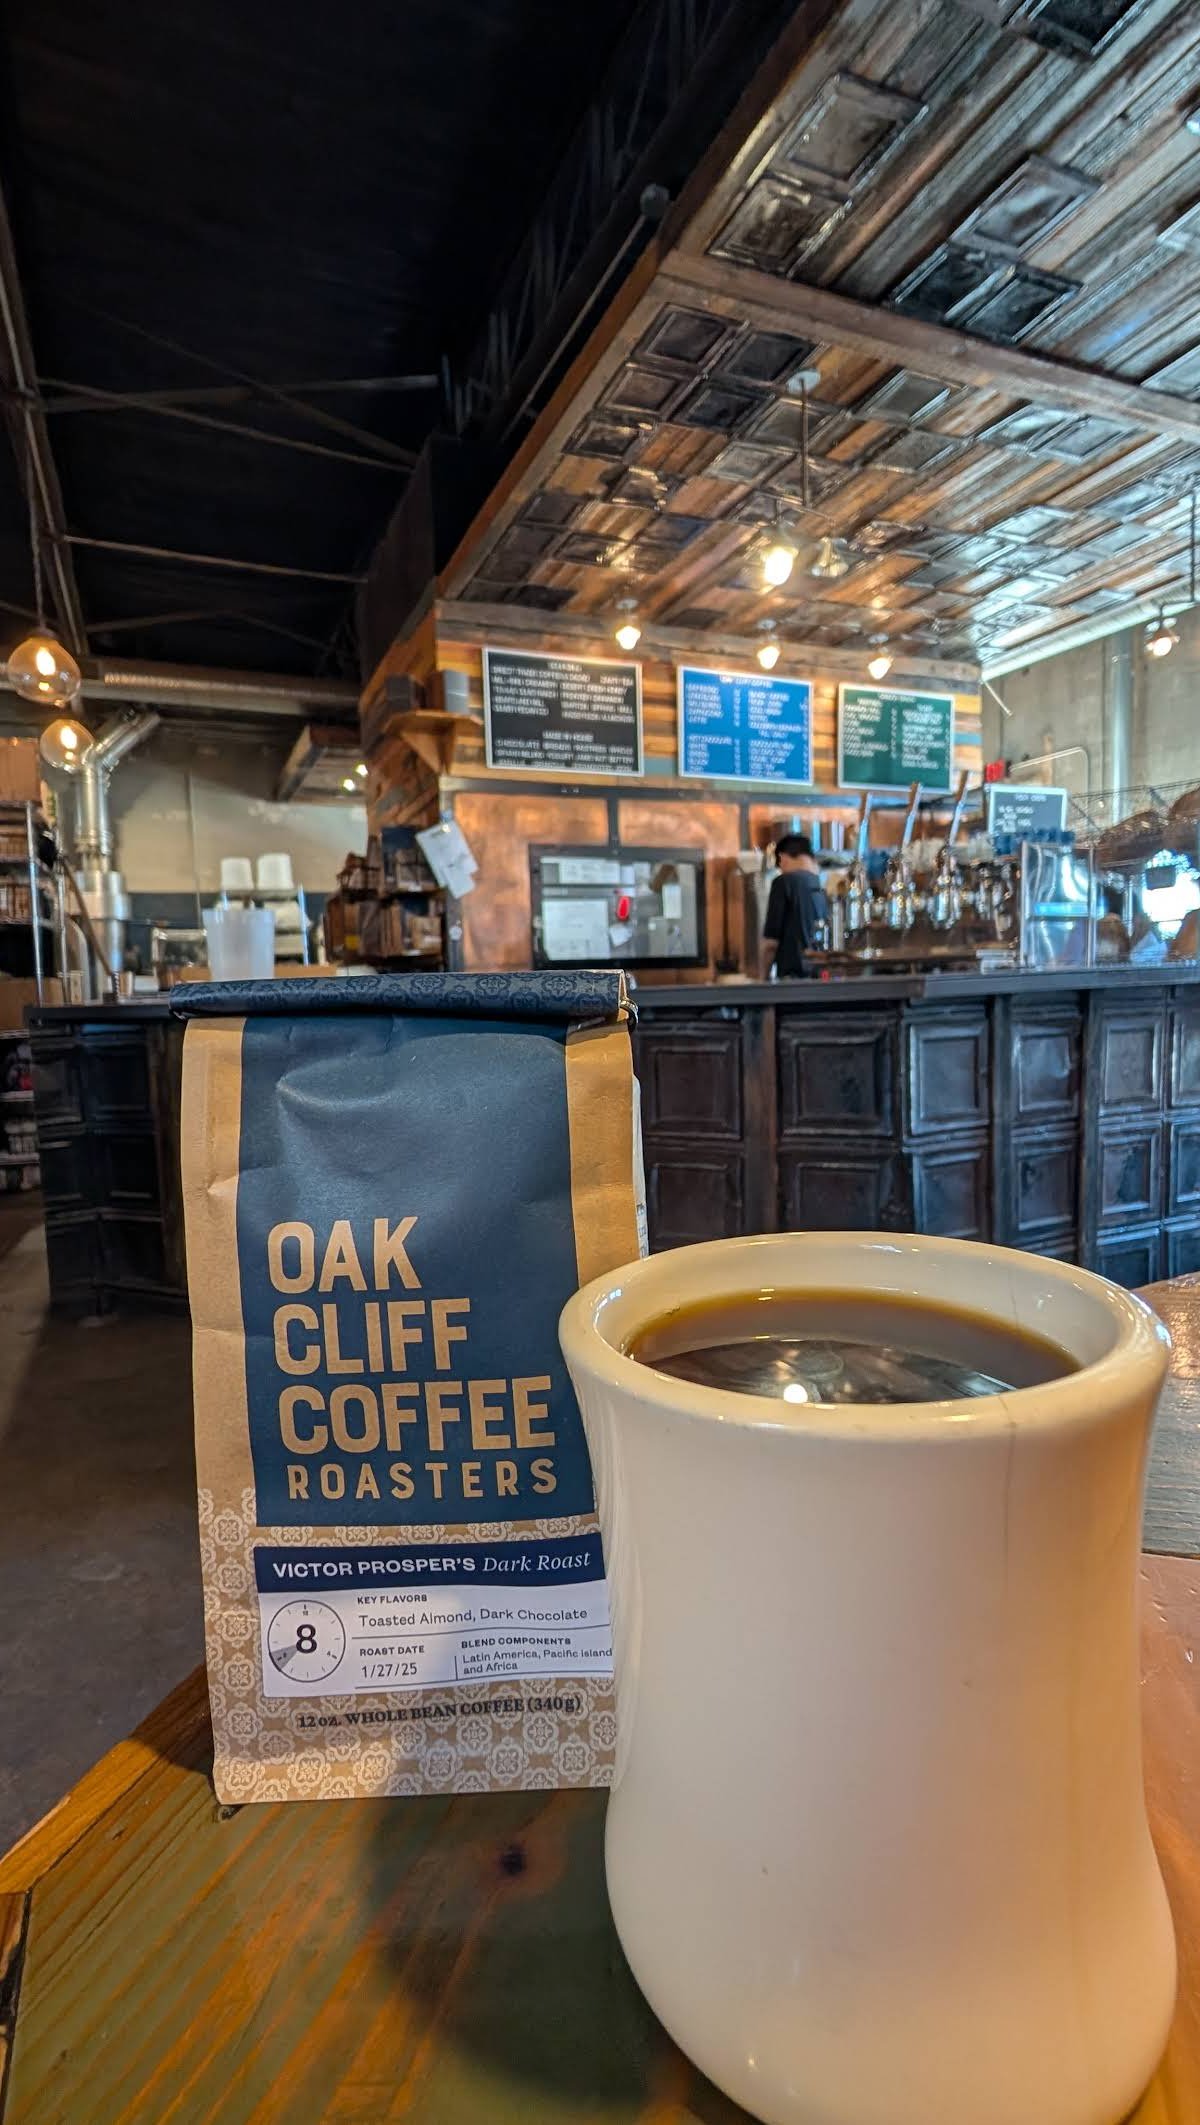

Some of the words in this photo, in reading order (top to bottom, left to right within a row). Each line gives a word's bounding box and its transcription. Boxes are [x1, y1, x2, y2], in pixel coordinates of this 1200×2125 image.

[267, 1216, 422, 1294] OAK
[273, 1297, 471, 1376] CLIFF
[279, 1375, 556, 1455] COFFEE
[287, 1458, 558, 1500] ROASTERS
[273, 1563, 353, 1578] VICTOR
[358, 1557, 476, 1575] PROSPER'S
[482, 1556, 532, 1572] Dark
[537, 1552, 591, 1571] Roast
[357, 1596, 377, 1604] KEY
[380, 1594, 428, 1604] FLAVORS
[359, 1614, 415, 1627] Toasted
[420, 1610, 476, 1625] Almond,
[480, 1608, 513, 1620] Dark
[518, 1609, 588, 1621] Chocolate
[296, 1624, 317, 1654] 8
[461, 1638, 496, 1649] BLEND
[498, 1637, 571, 1646] COMPONENTS
[360, 1647, 394, 1656] ROAST
[397, 1645, 425, 1655] DATE
[463, 1653, 491, 1663] Latin
[493, 1649, 541, 1661] America,
[543, 1648, 578, 1658] Pacific
[361, 1662, 418, 1678] 1/27/25
[463, 1665, 484, 1675] and
[486, 1662, 518, 1672] Africa
[299, 1717, 316, 1728] 12
[319, 1717, 343, 1728] oz.
[347, 1711, 408, 1725] WHOLE
[411, 1705, 457, 1720] BEAN
[460, 1700, 525, 1717] COFFEE
[528, 1695, 582, 1714] (340g)
